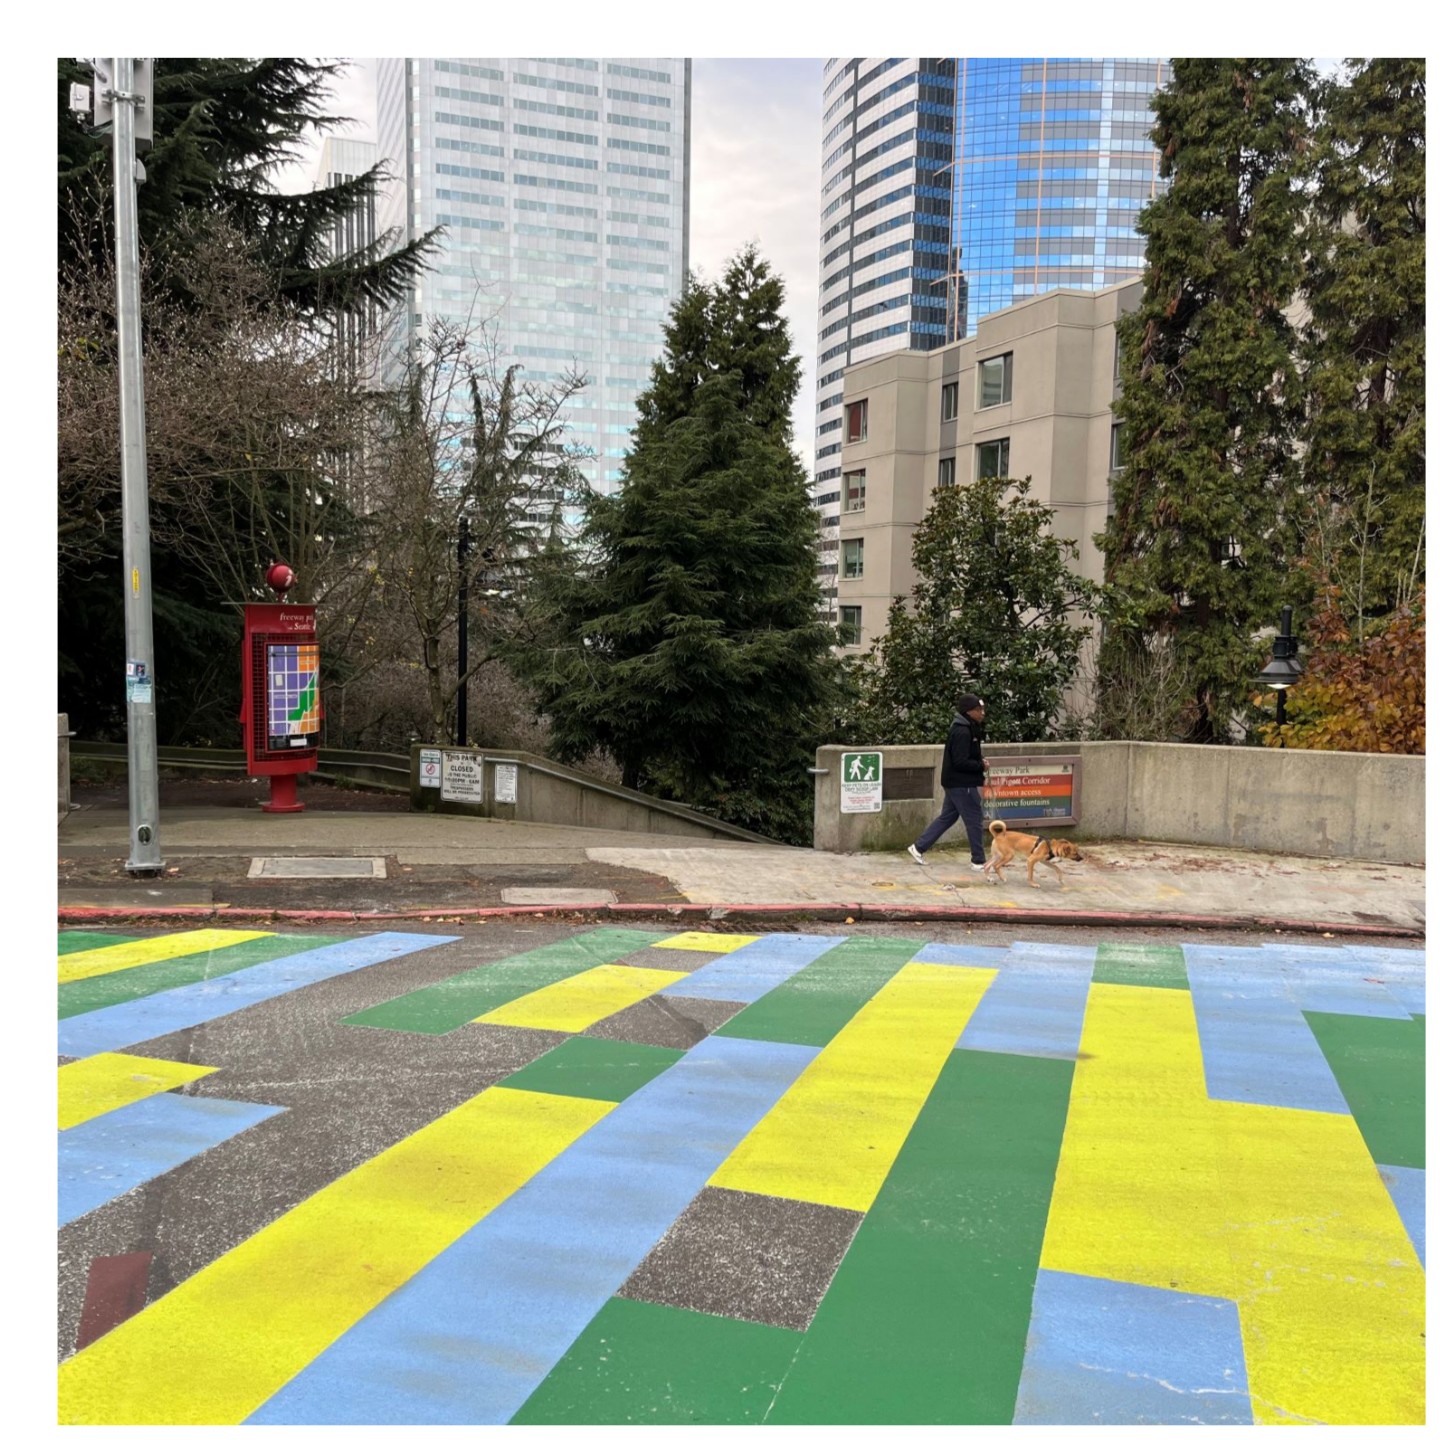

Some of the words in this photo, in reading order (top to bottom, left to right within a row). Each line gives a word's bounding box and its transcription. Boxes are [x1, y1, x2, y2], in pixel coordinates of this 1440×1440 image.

[1015, 765, 1030, 774] Park
[1022, 776, 1051, 785] Corridor
[984, 799, 1019, 808] decorative
